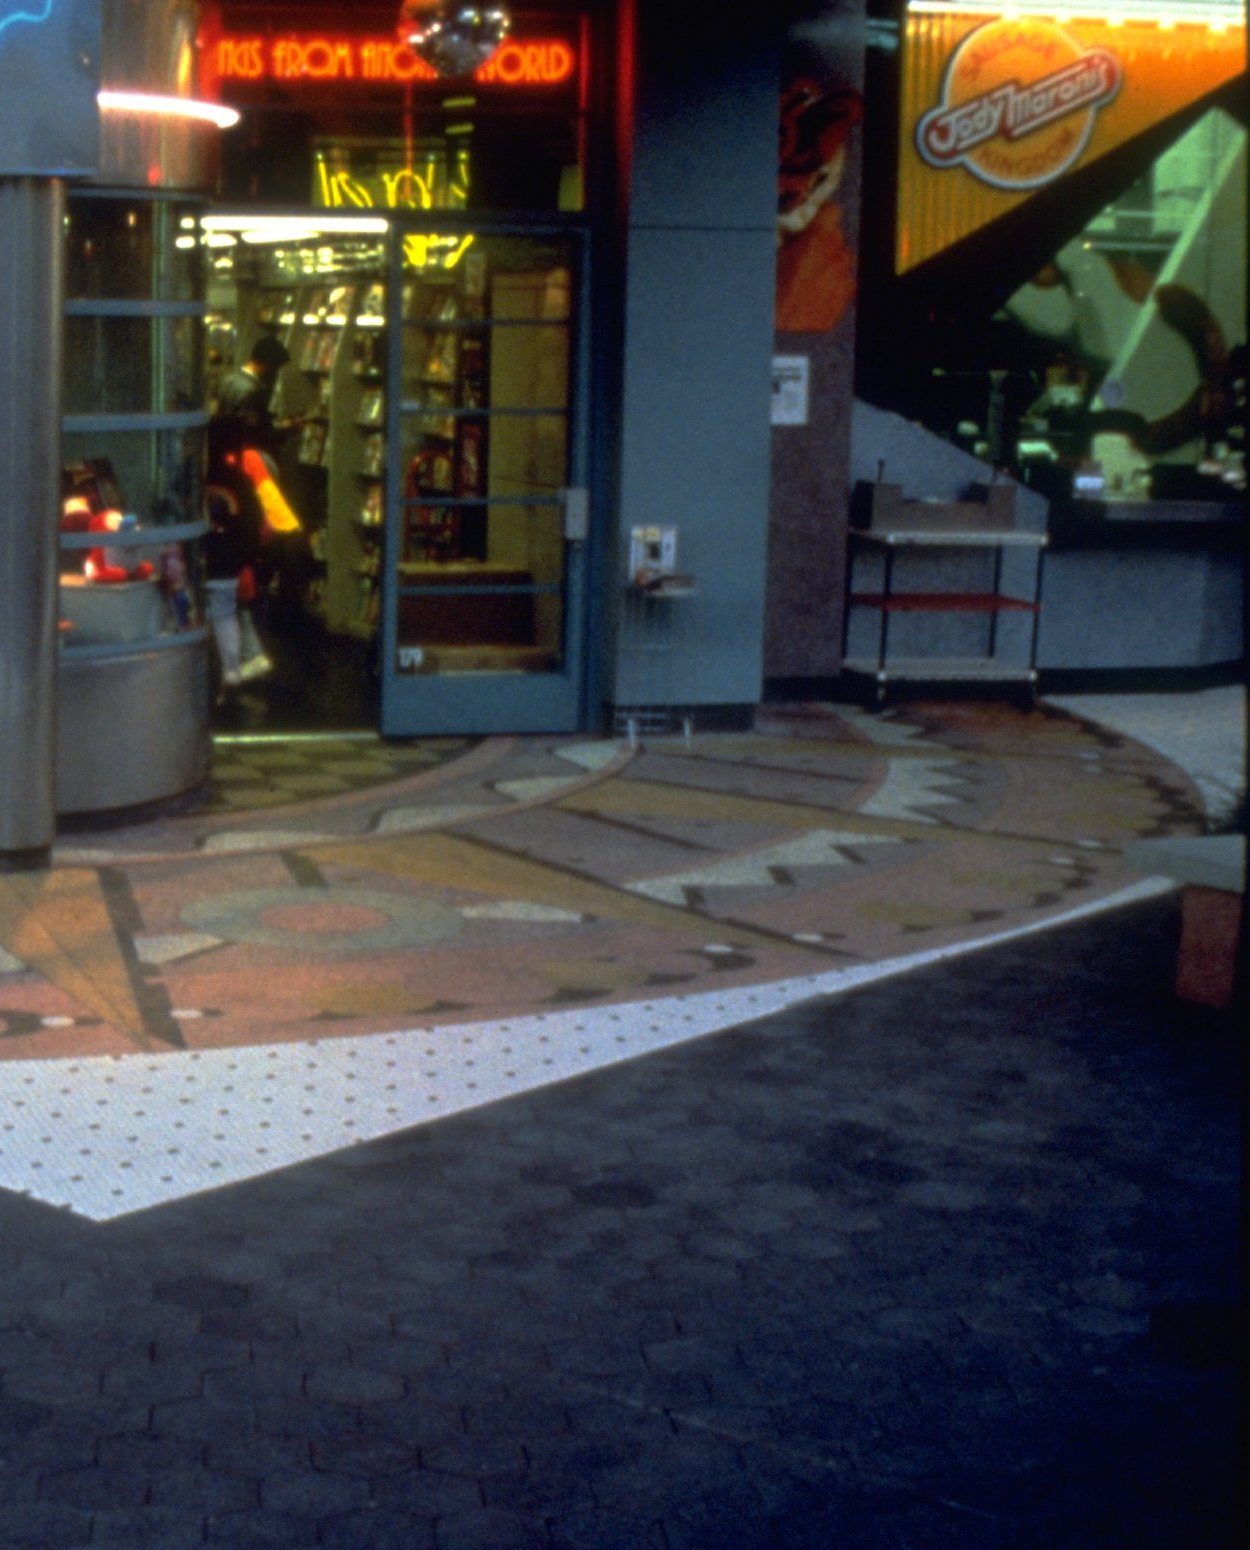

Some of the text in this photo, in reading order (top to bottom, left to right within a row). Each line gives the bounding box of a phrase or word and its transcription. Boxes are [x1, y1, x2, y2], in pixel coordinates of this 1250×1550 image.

[217, 40, 264, 77] NGS
[272, 40, 354, 77] FROM
[928, 98, 1004, 152] Jody
